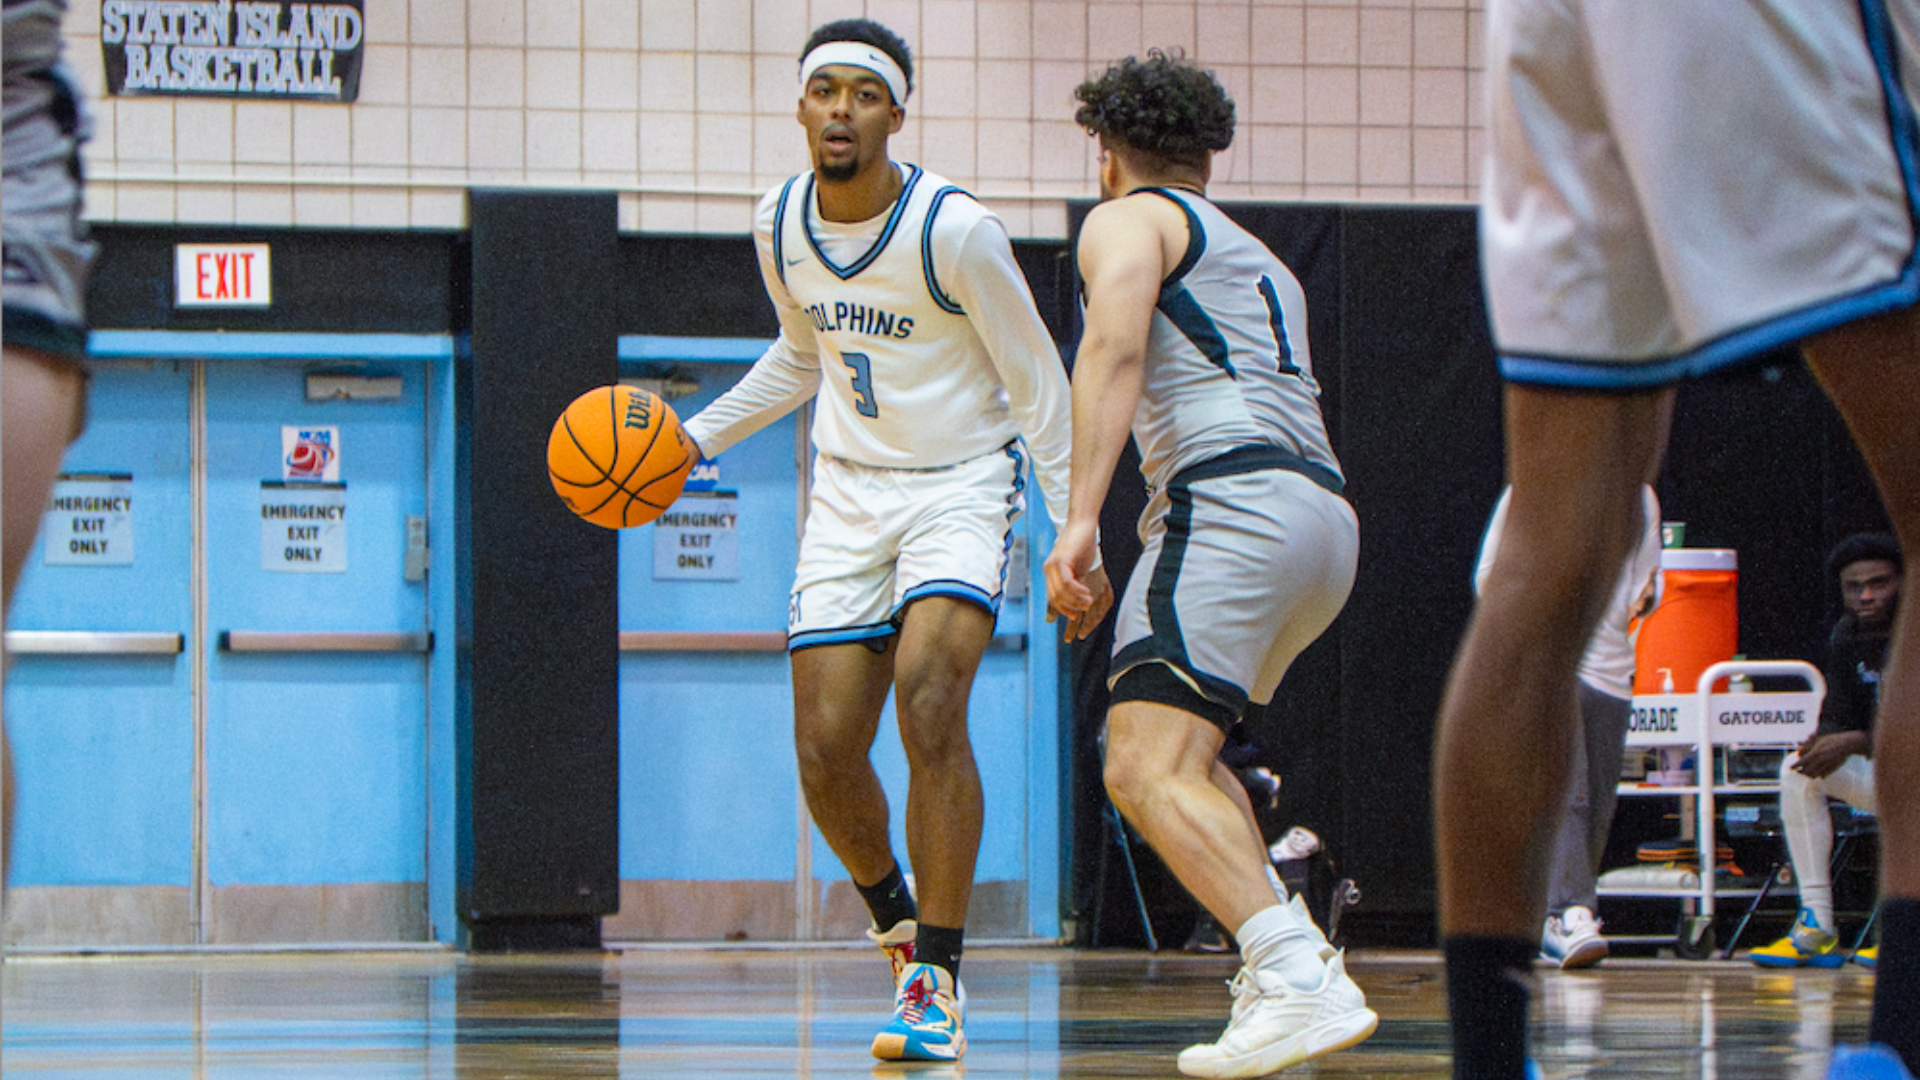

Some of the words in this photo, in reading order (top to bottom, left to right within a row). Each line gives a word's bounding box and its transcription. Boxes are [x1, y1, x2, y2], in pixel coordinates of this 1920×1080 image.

[103, 1, 230, 46] STATEN
[235, 2, 363, 50] ISLAND
[125, 45, 342, 94] BASKETBALL
[196, 253, 255, 299] EXIT
[1255, 273, 1302, 376] 1
[840, 351, 878, 419] 3
[52, 497, 132, 512] MERGENCY
[261, 504, 346, 520] EMERGENCY
[72, 518, 105, 533] EXIT
[287, 526, 319, 541] EXIT
[680, 533, 712, 548] EXIT
[69, 539, 109, 554] ONLY
[284, 547, 322, 562] ONLY
[677, 555, 714, 569] ONLY
[1719, 710, 1806, 726] GATORADE
